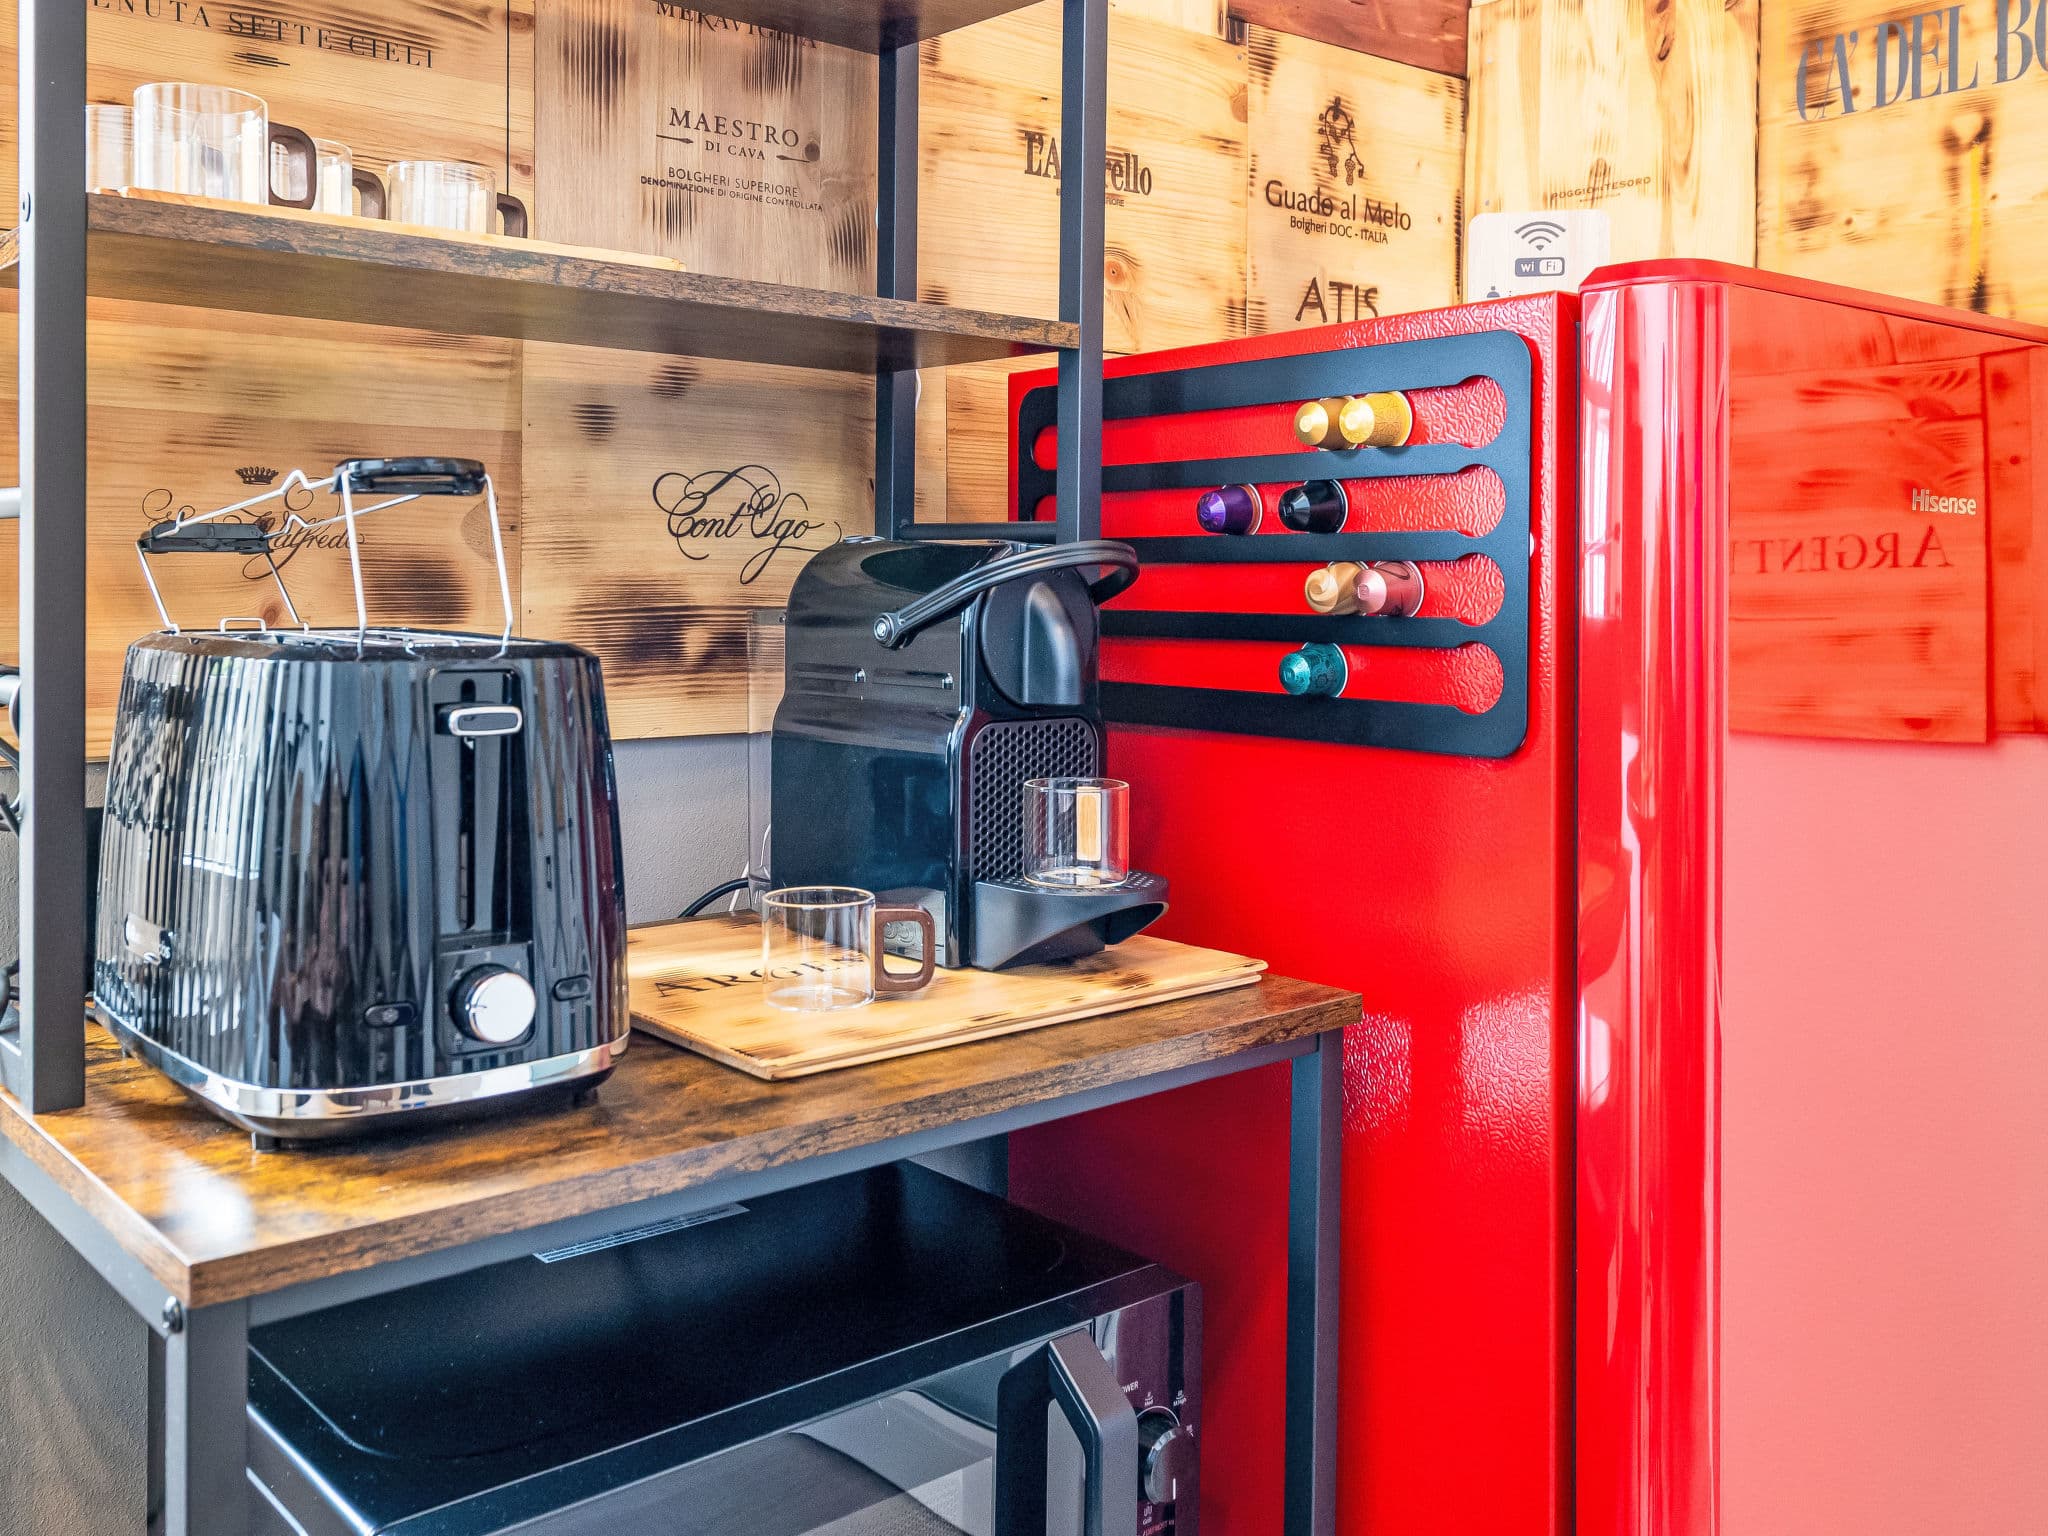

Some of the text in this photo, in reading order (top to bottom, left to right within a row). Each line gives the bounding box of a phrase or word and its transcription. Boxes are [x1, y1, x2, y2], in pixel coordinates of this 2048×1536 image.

[93, 0, 433, 69] NUTA SETTE CIELI
[1872, 4, 1978, 109] DEL
[669, 107, 799, 148] MAESTRO
[705, 140, 766, 160] DI CAVA
[640, 175, 823, 212] DENOMINAZIONE DI ORIGINE CONTROLLATA
[668, 166, 799, 198] BOLGHERI SUPERIORE
[1265, 180, 1411, 231] Guado al Melo
[1290, 215, 1327, 235] Bolgheri
[1329, 222, 1353, 238] DOC
[1360, 228, 1389, 245] ITALIA
[1295, 277, 1379, 324] ATIS
[1911, 488, 1977, 515] Hisense
